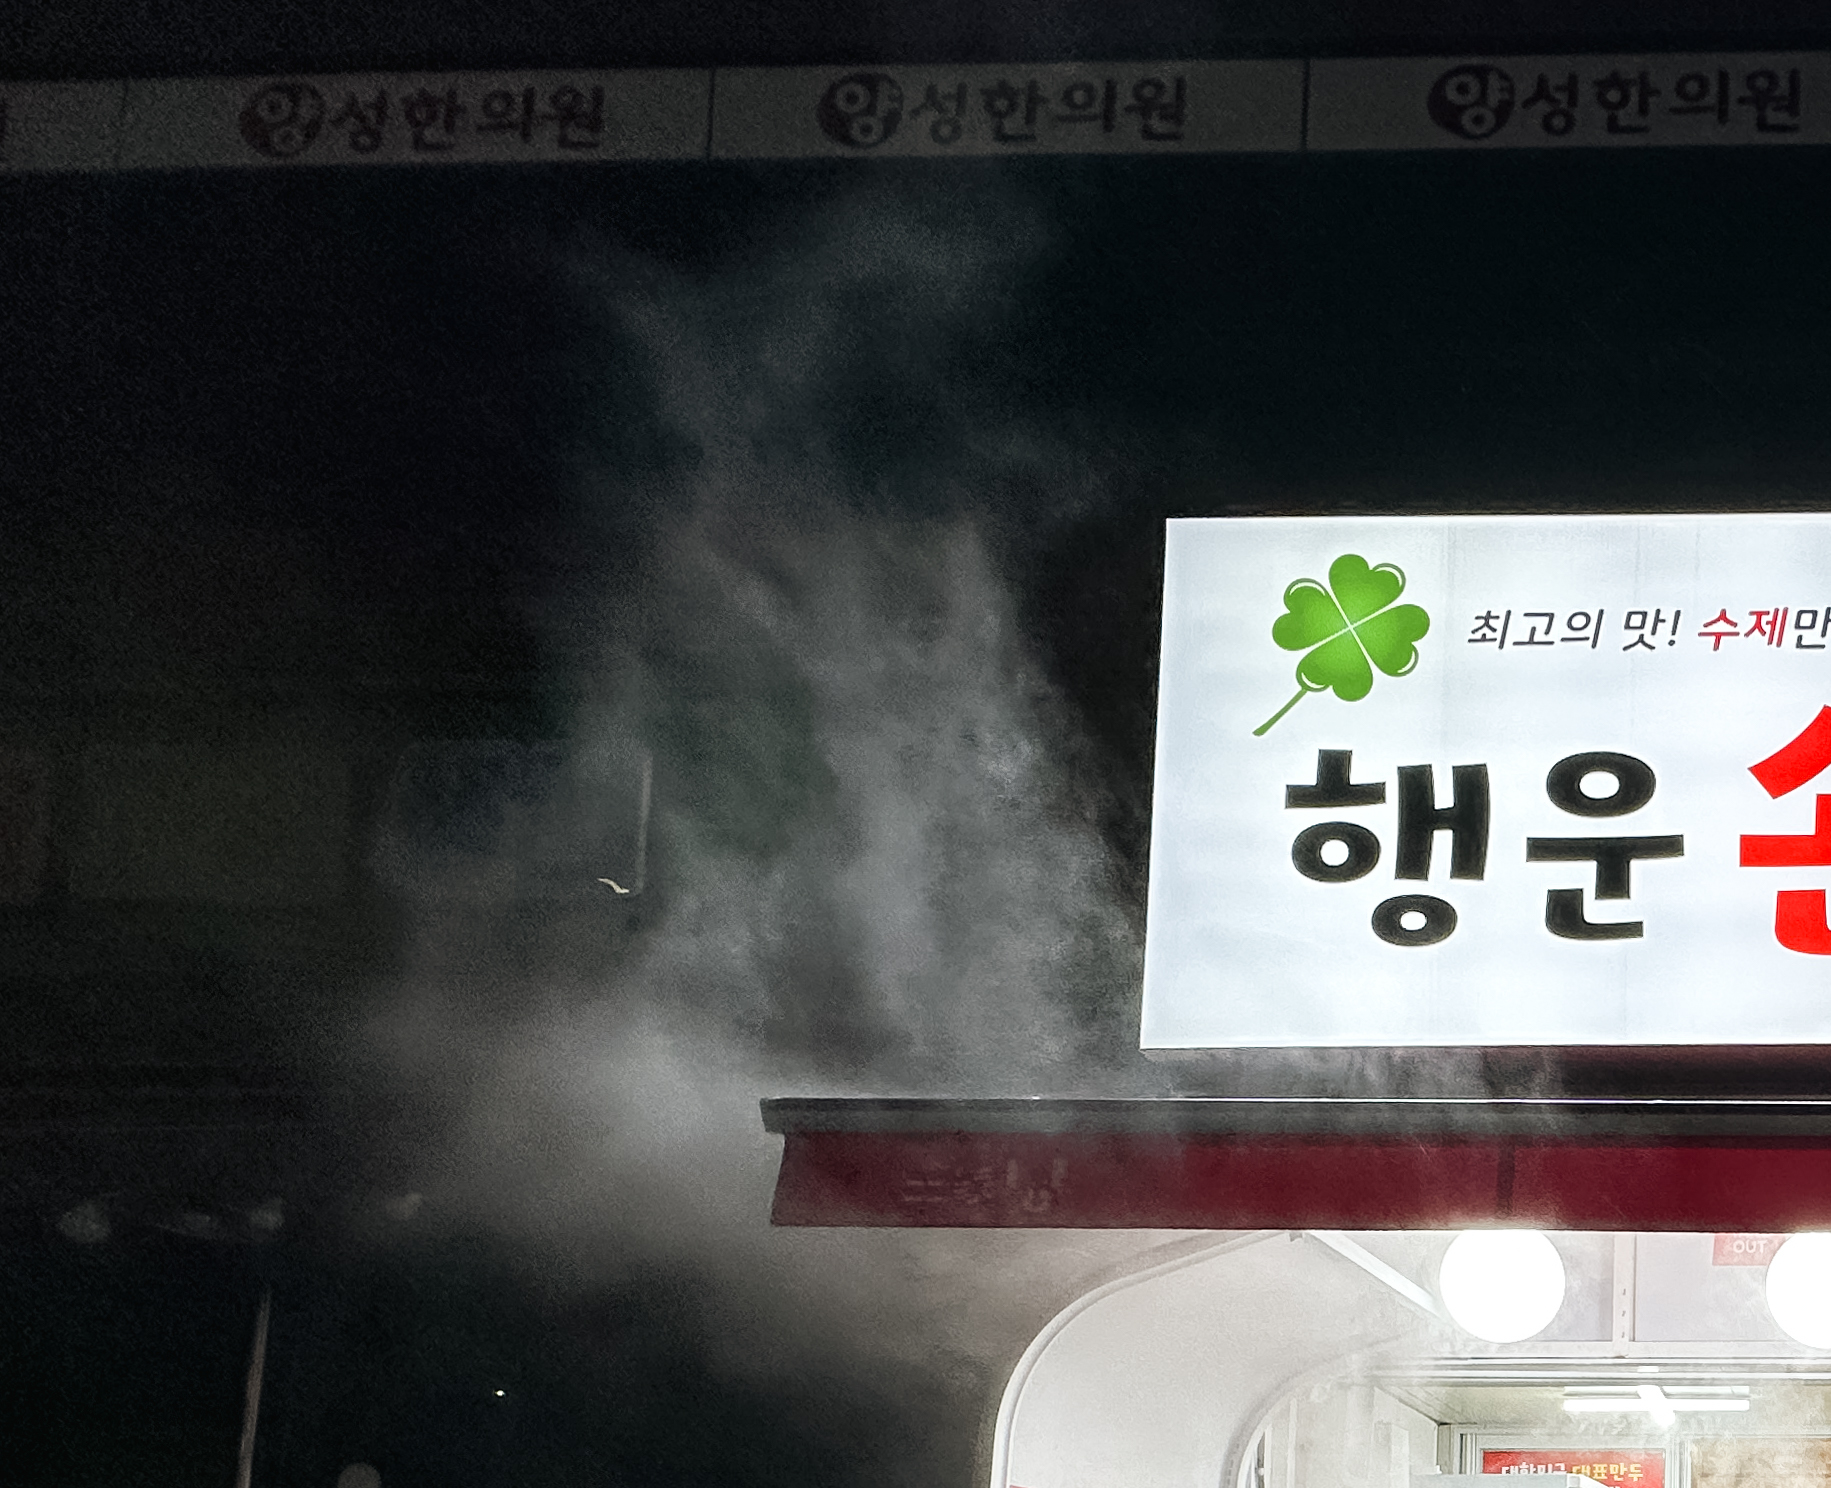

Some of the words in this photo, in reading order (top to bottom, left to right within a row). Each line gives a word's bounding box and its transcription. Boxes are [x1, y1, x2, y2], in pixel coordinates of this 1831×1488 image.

[1468, 606, 1604, 649] 최고의
[1621, 606, 1680, 648] 맛!
[1572, 1462, 1645, 1482] 대표만두
